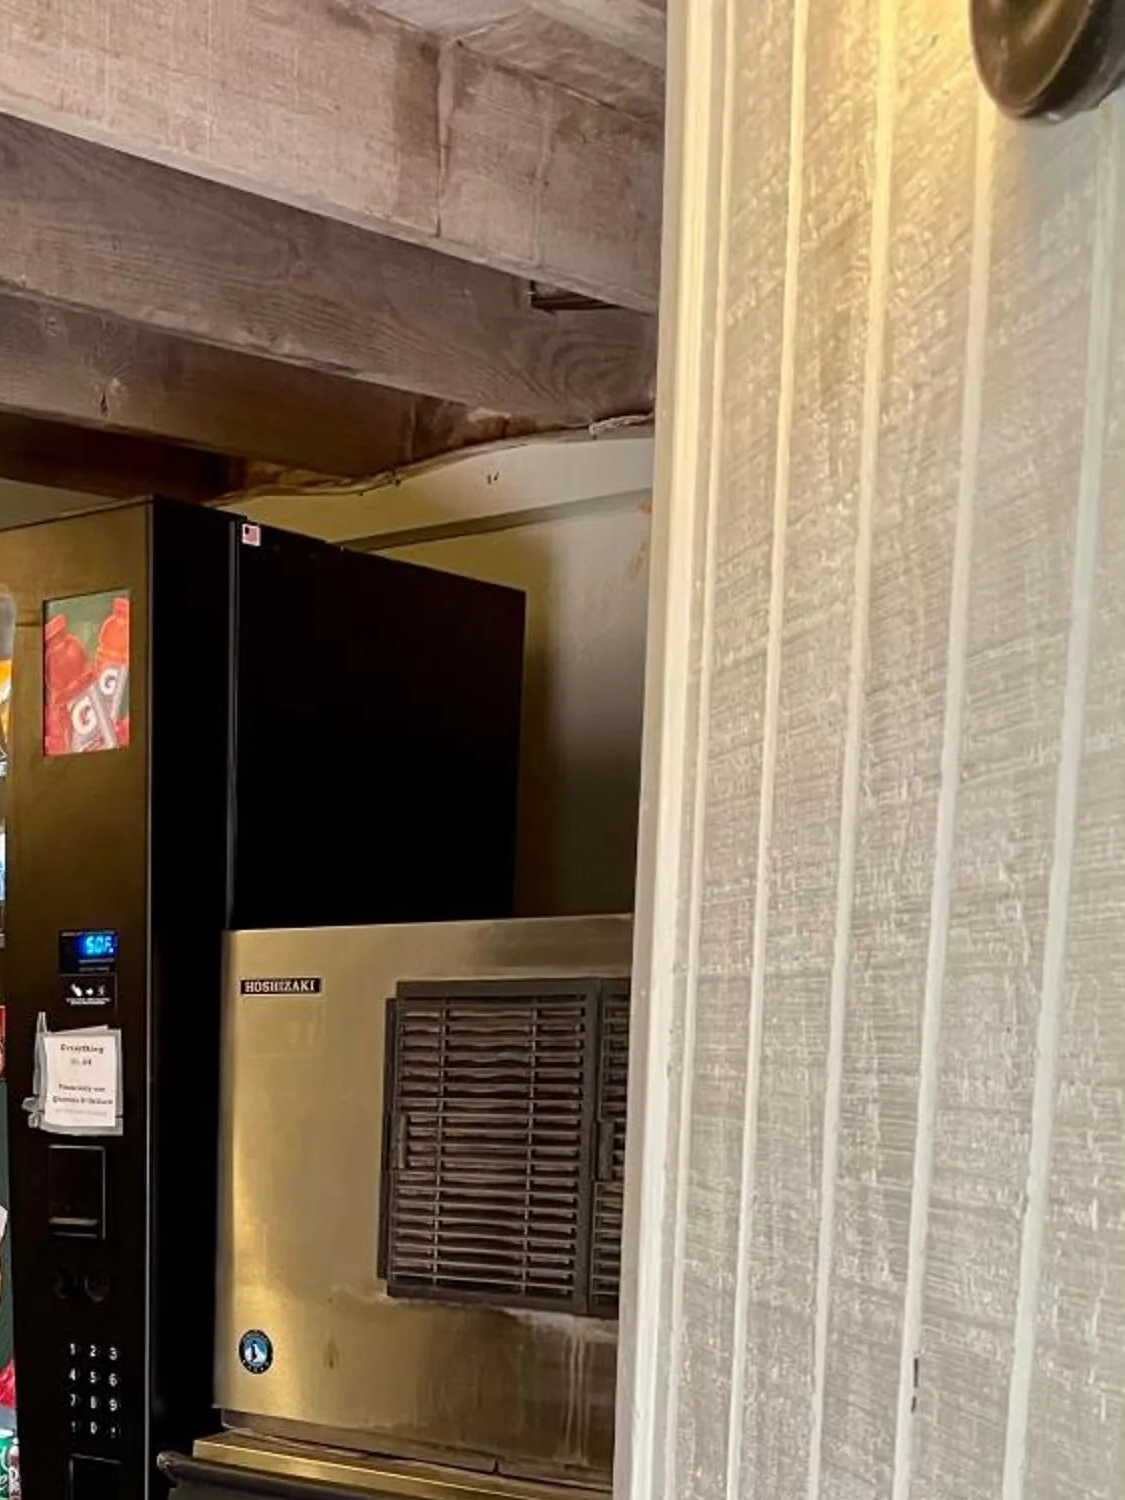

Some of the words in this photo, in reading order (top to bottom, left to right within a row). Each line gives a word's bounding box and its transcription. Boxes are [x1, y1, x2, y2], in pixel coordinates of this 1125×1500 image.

[99, 668, 120, 696] G
[72, 696, 98, 734] G
[244, 980, 316, 993] HOSHIZAKI
[90, 1344, 97, 1357] 2
[109, 1347, 118, 1361] 3
[90, 1370, 97, 1384] 5
[109, 1373, 118, 1387] 6
[109, 1398, 118, 1412] 9
